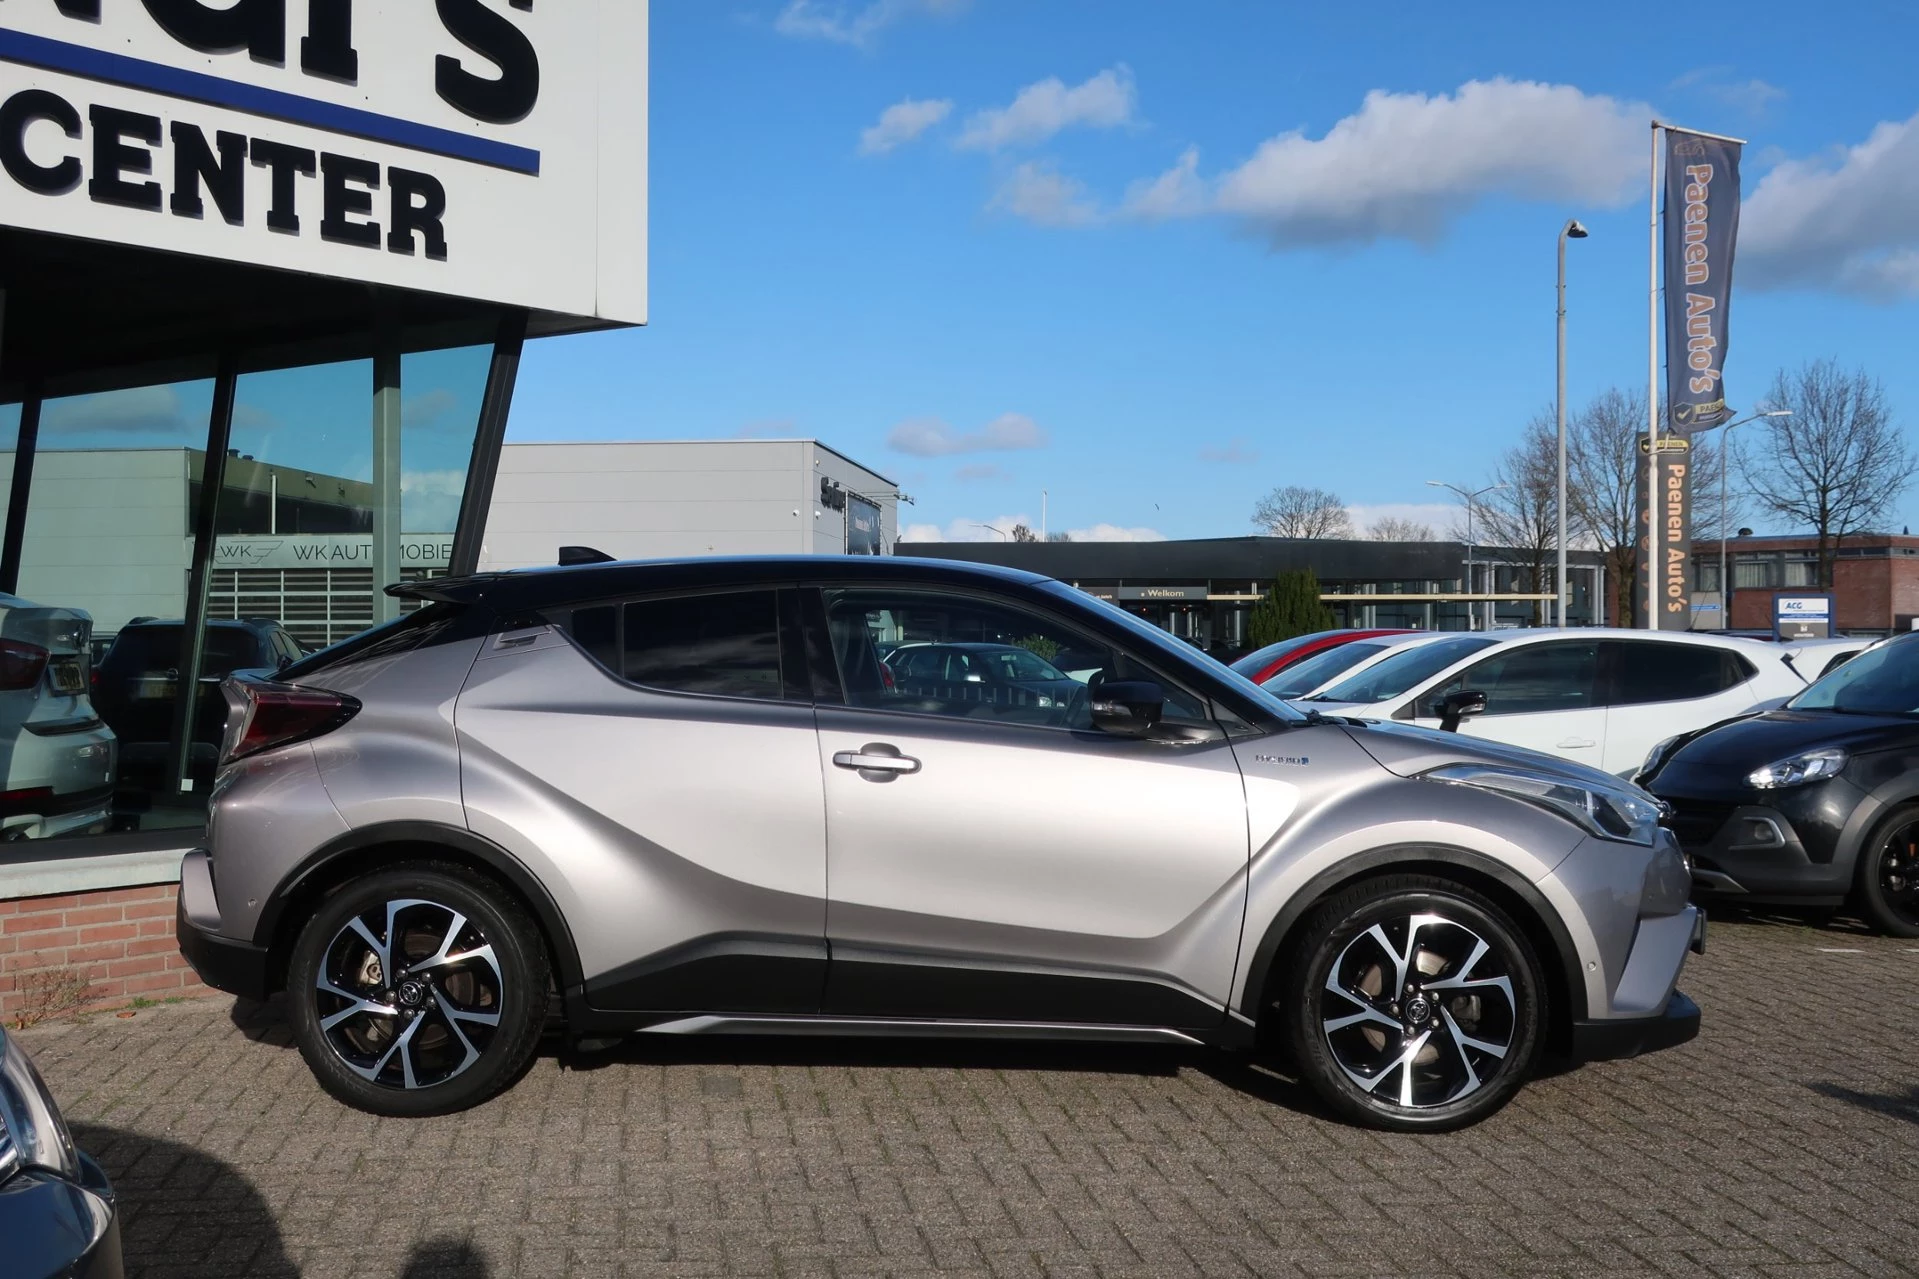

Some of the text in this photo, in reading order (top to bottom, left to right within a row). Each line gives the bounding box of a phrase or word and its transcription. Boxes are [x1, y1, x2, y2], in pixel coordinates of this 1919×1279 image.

[0, 89, 448, 262] CENTER
[1685, 163, 1714, 286] Paenen
[1686, 292, 1721, 394] Auto's
[1667, 464, 1686, 542] Paenen
[219, 545, 252, 558] WK
[293, 544, 328, 560] WK
[1667, 548, 1688, 613] Auto's
[1147, 588, 1185, 598] Welkom
